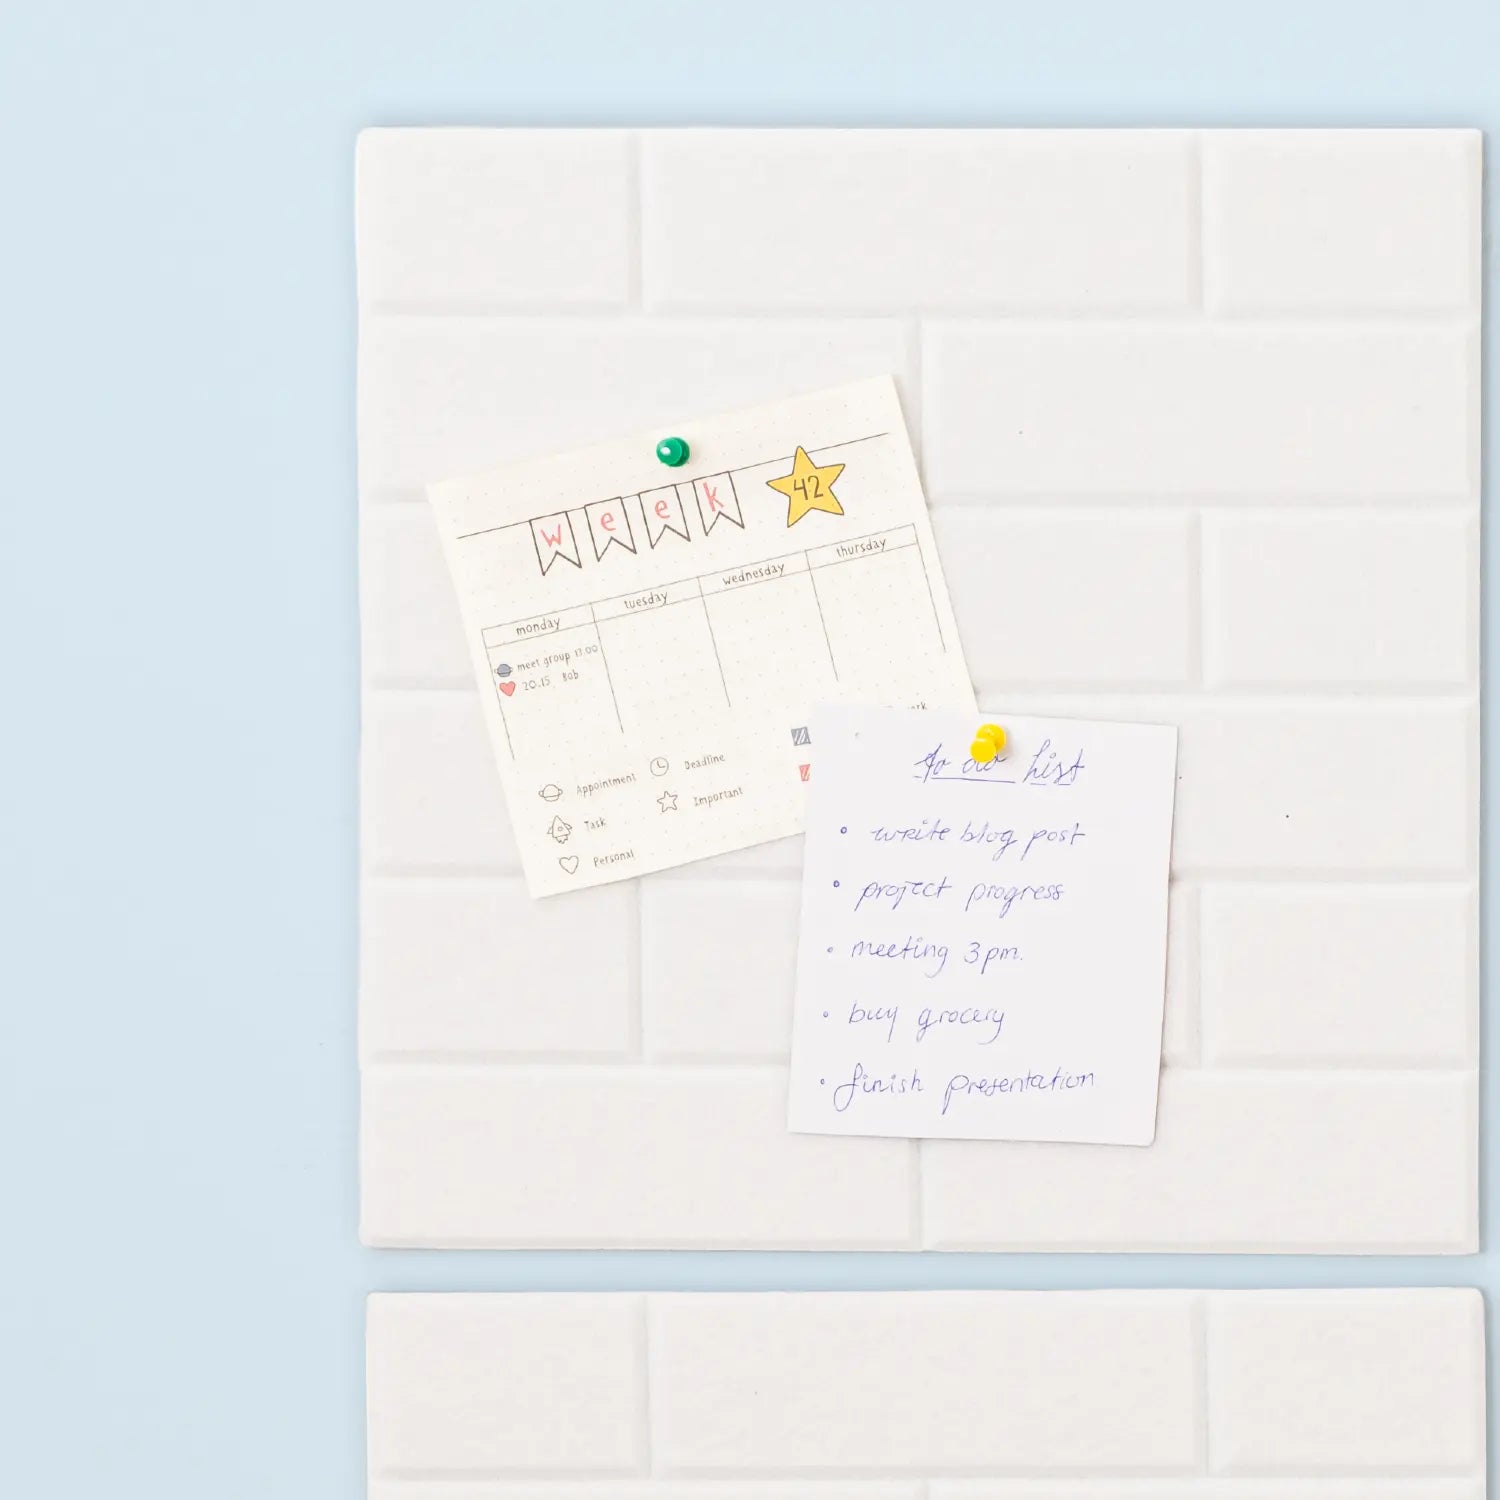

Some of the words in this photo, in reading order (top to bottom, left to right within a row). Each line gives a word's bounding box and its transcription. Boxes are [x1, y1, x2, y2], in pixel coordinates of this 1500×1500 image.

[793, 475, 824, 501] 42
[836, 537, 887, 558] thursday
[721, 562, 785, 586] wednesday
[624, 591, 668, 610] tuesday
[515, 617, 561, 636] monday
[517, 659, 540, 672] meet
[543, 652, 571, 668] group
[684, 754, 726, 770] Deadline
[576, 772, 637, 797] Appointment
[693, 787, 744, 807] Important
[583, 817, 607, 832] Task
[871, 819, 951, 842] write
[960, 820, 1018, 862] blog
[1020, 822, 1086, 861] post
[593, 849, 635, 867] Personal
[854, 876, 952, 911] project
[965, 882, 1064, 919] progress
[852, 935, 949, 979] meeting
[849, 1001, 898, 1043] buy
[917, 1007, 1005, 1045] grocery
[833, 1062, 924, 1112] finish
